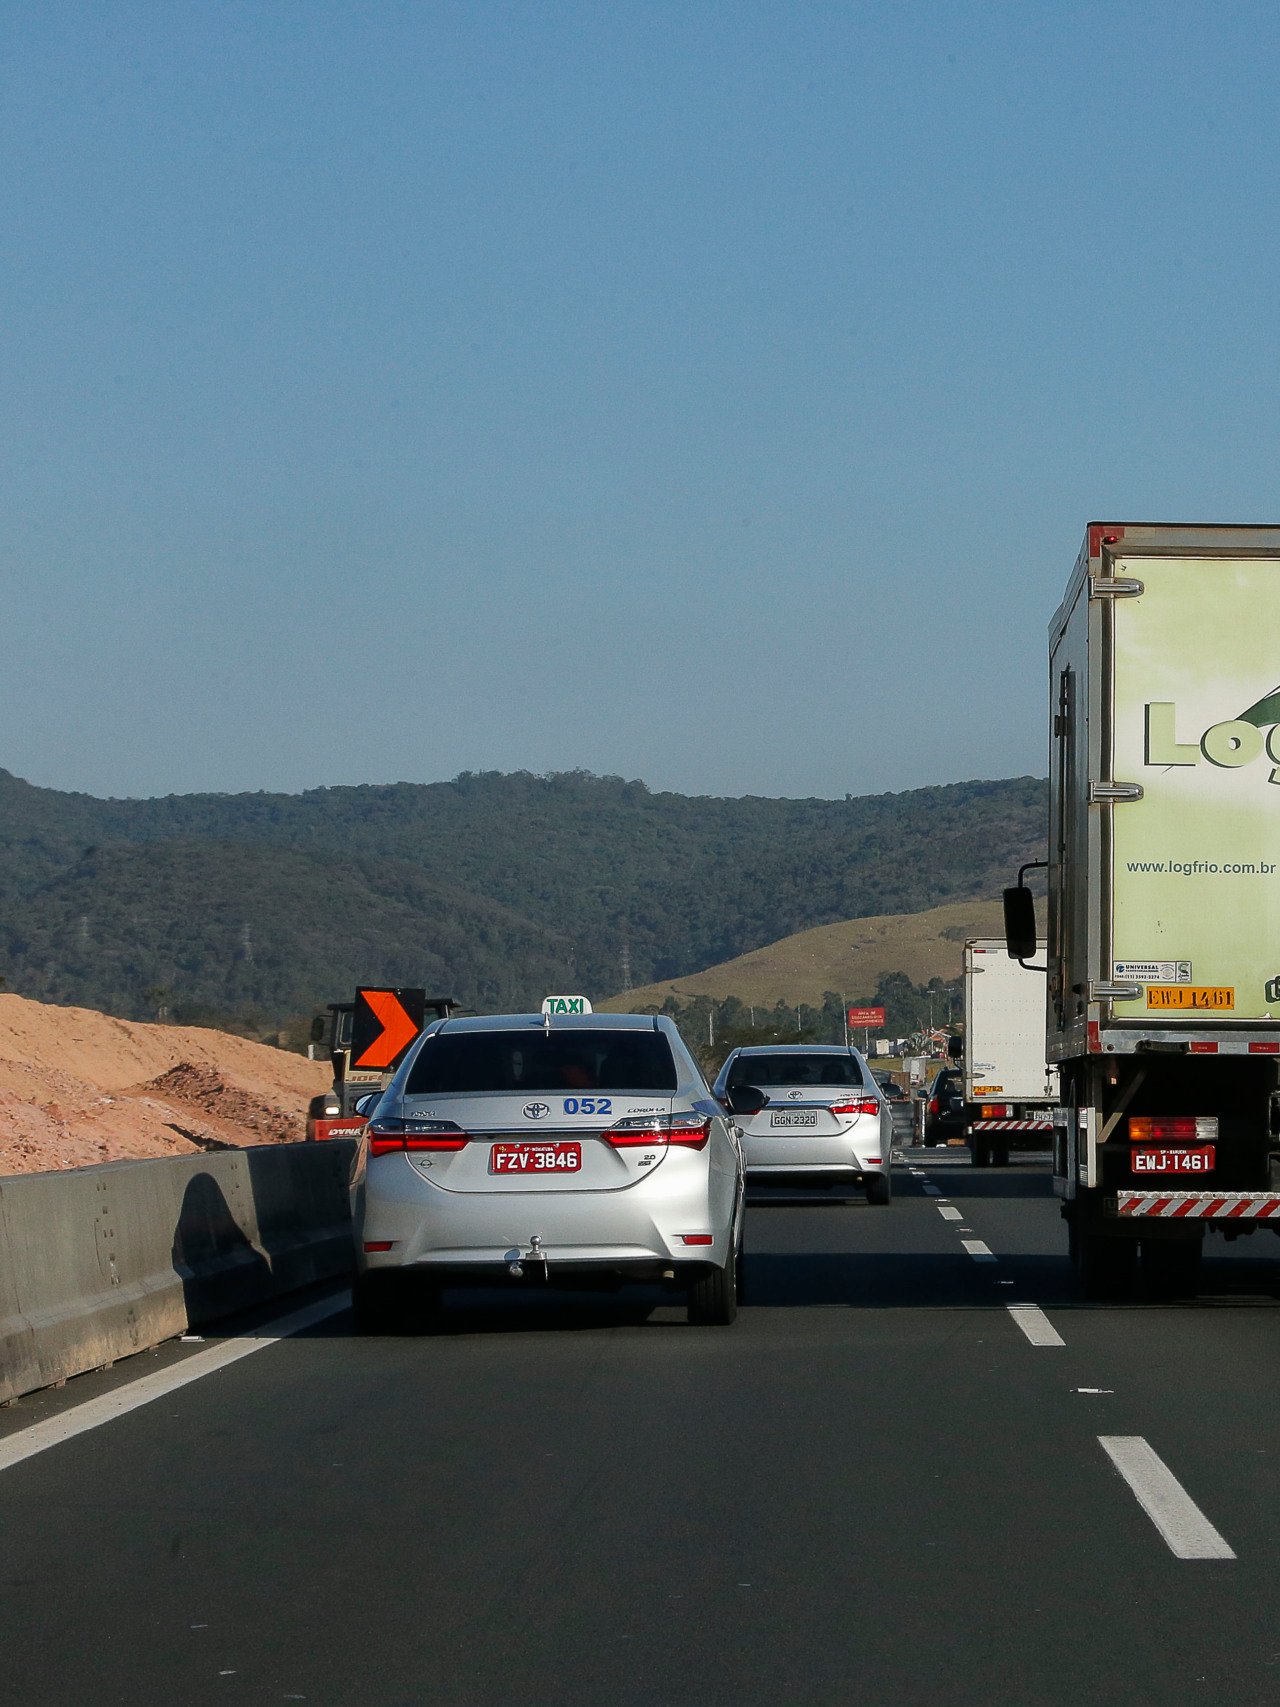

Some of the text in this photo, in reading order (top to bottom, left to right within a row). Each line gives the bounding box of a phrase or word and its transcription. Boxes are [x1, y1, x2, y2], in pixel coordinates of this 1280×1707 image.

[1126, 860, 1277, 876] www.logfrio.com.br
[546, 998, 584, 1014] TAXI
[1148, 990, 1232, 1007] EWJ 1461
[563, 1098, 613, 1115] 052
